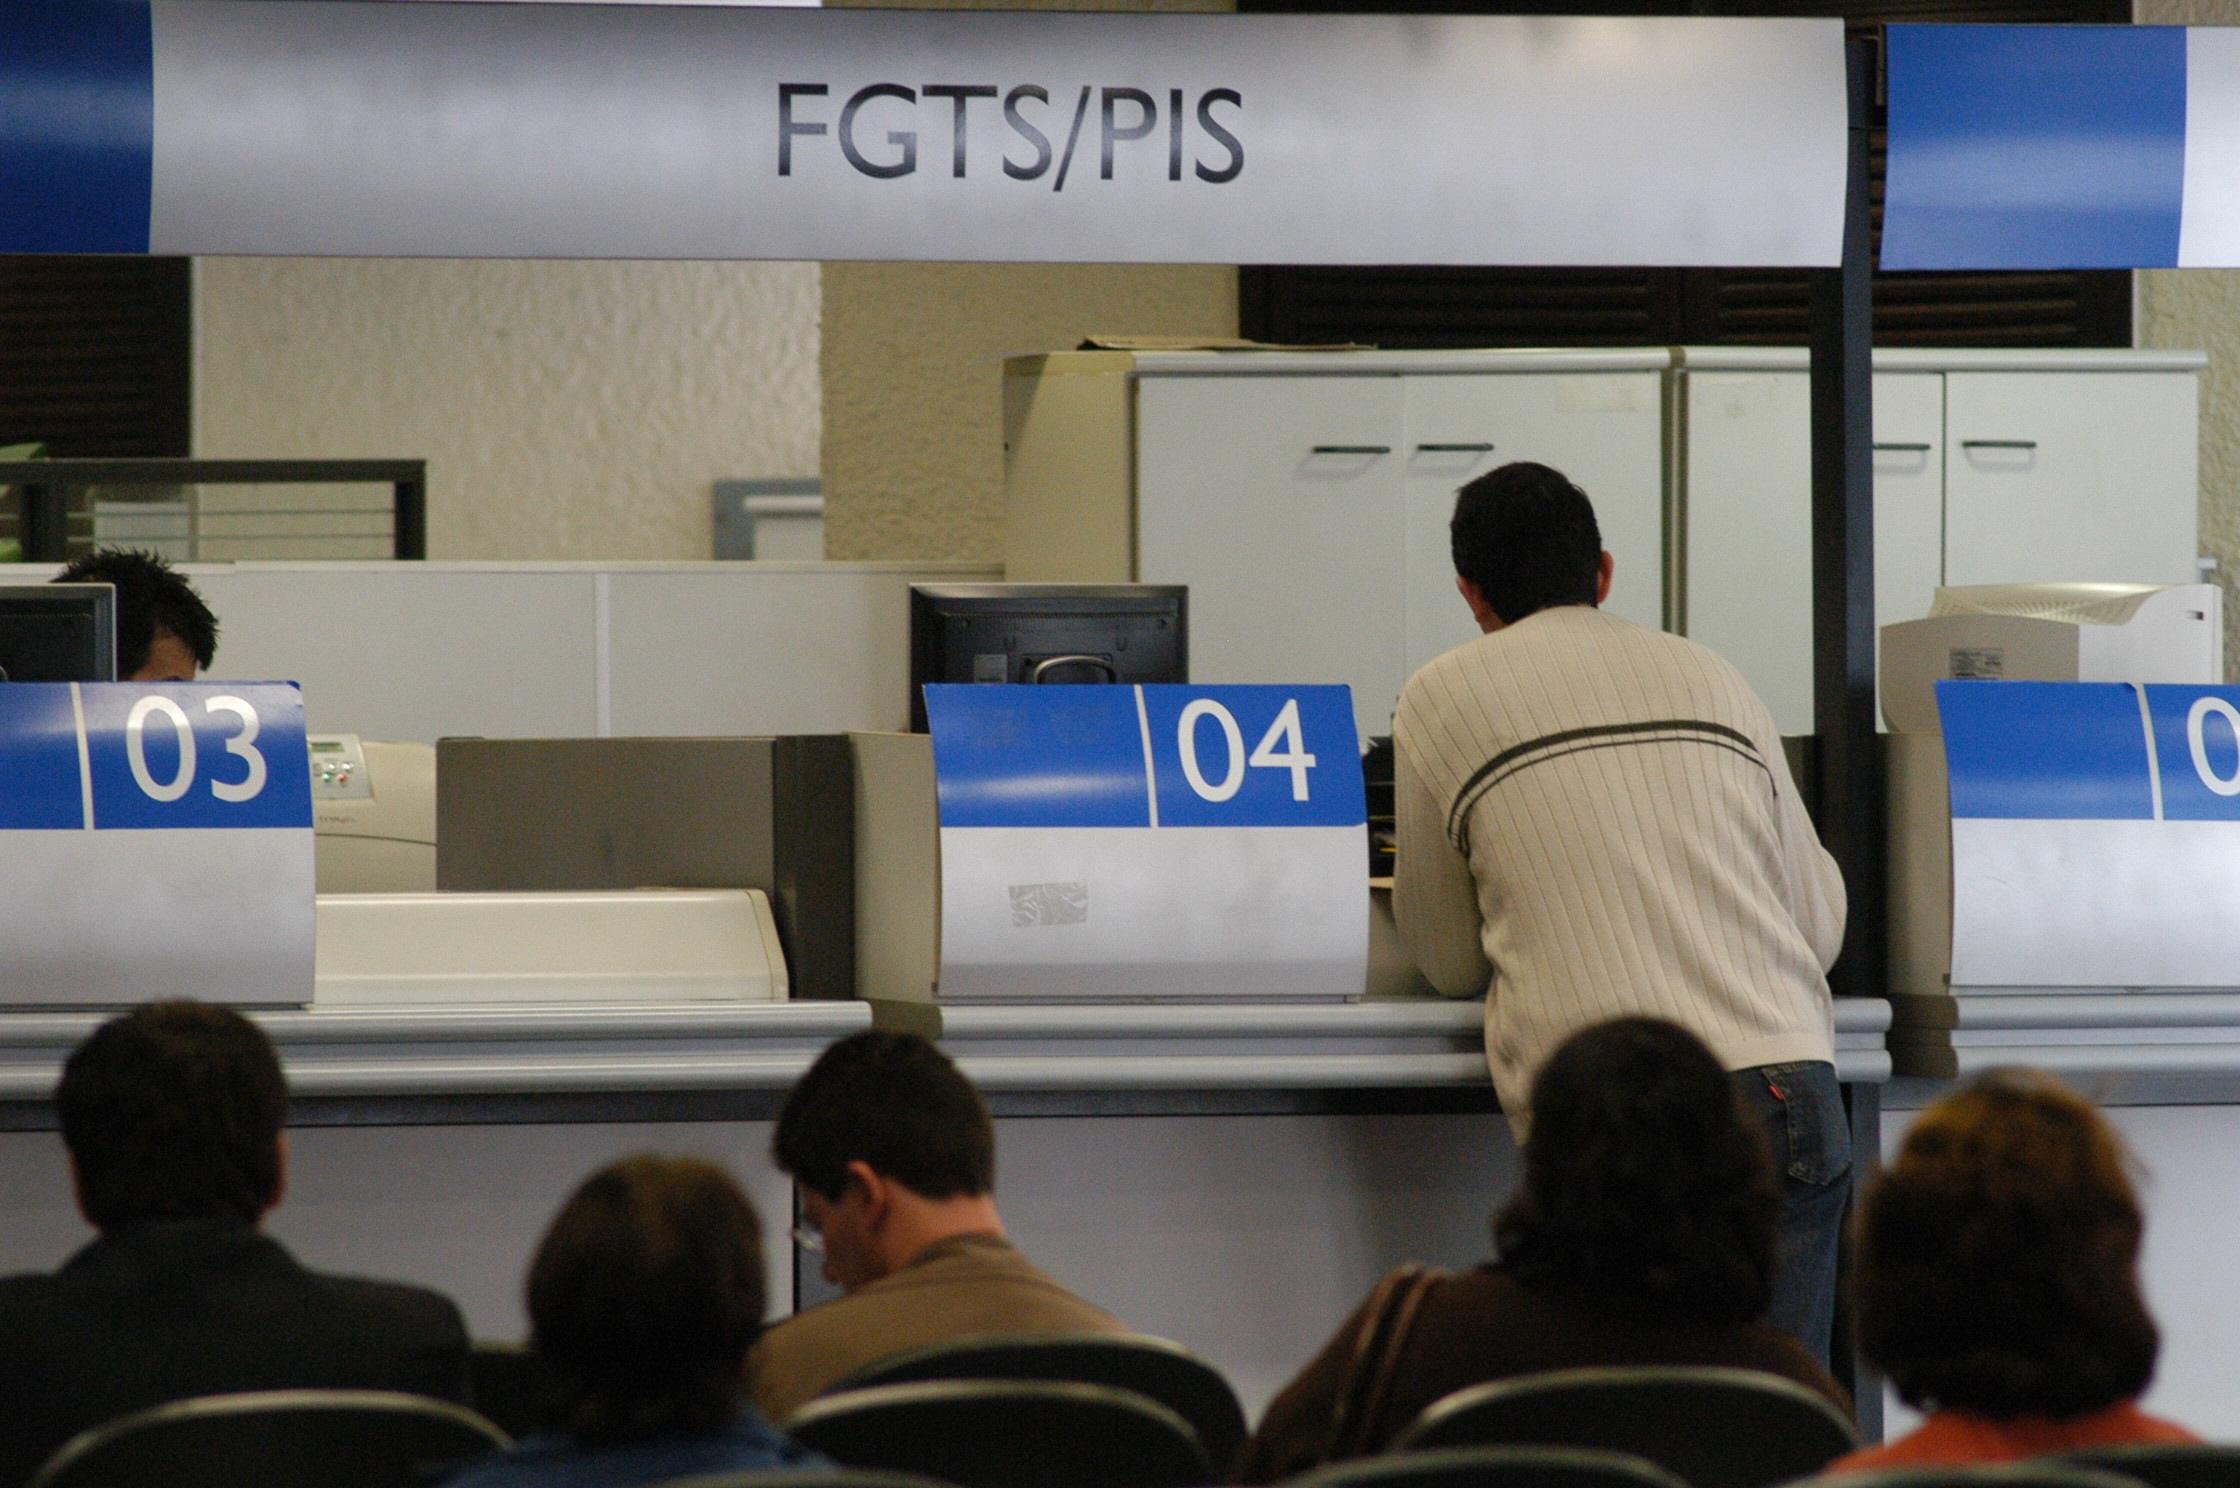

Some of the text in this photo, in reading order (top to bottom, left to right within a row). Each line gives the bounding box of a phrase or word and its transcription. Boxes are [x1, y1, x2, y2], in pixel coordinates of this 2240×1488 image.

[778, 82, 1244, 191] FGTS/PIS
[126, 695, 267, 802] 03
[1177, 698, 1316, 802] 04
